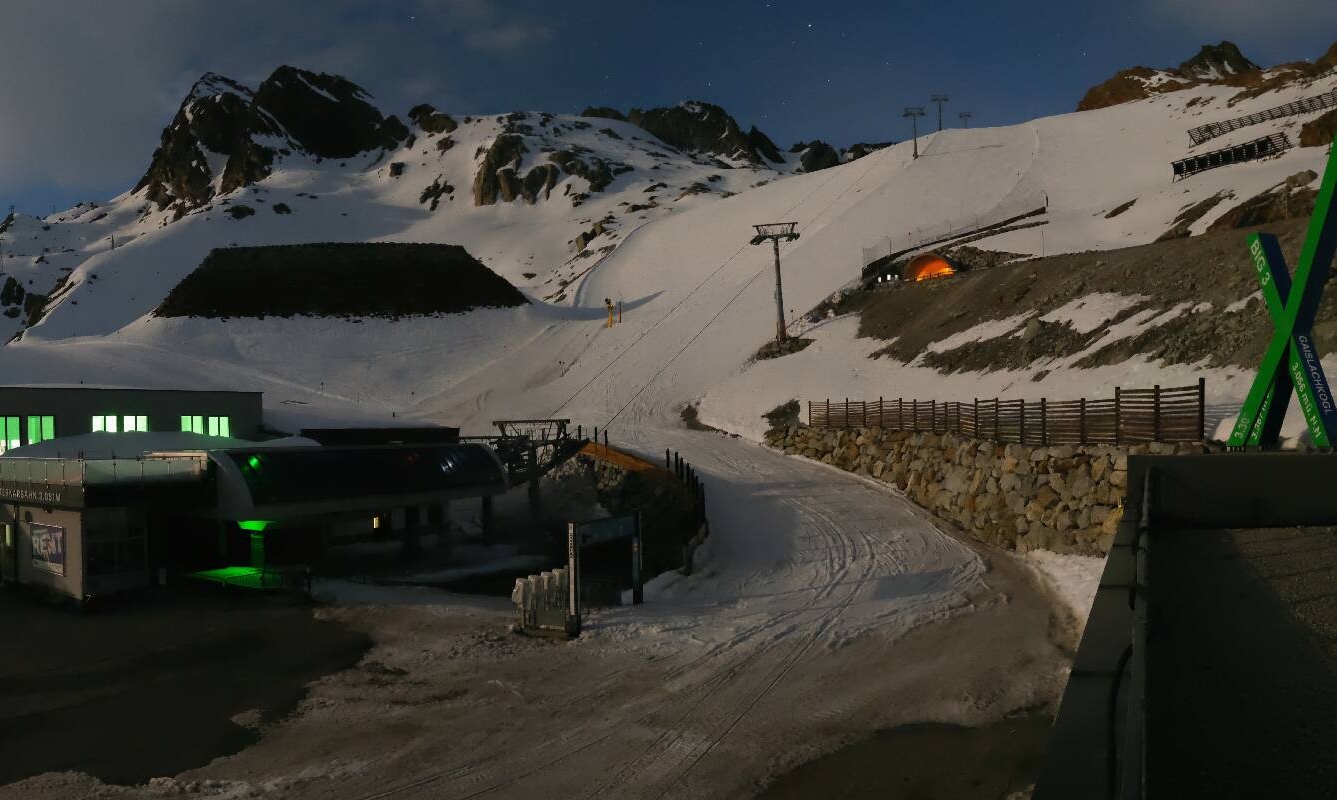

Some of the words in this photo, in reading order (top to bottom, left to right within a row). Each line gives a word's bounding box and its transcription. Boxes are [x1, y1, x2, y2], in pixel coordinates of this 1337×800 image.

[1251, 240, 1265, 272] BIG
[1262, 272, 1270, 286] 3
[1298, 335, 1332, 413] GAISLACHKOGL
